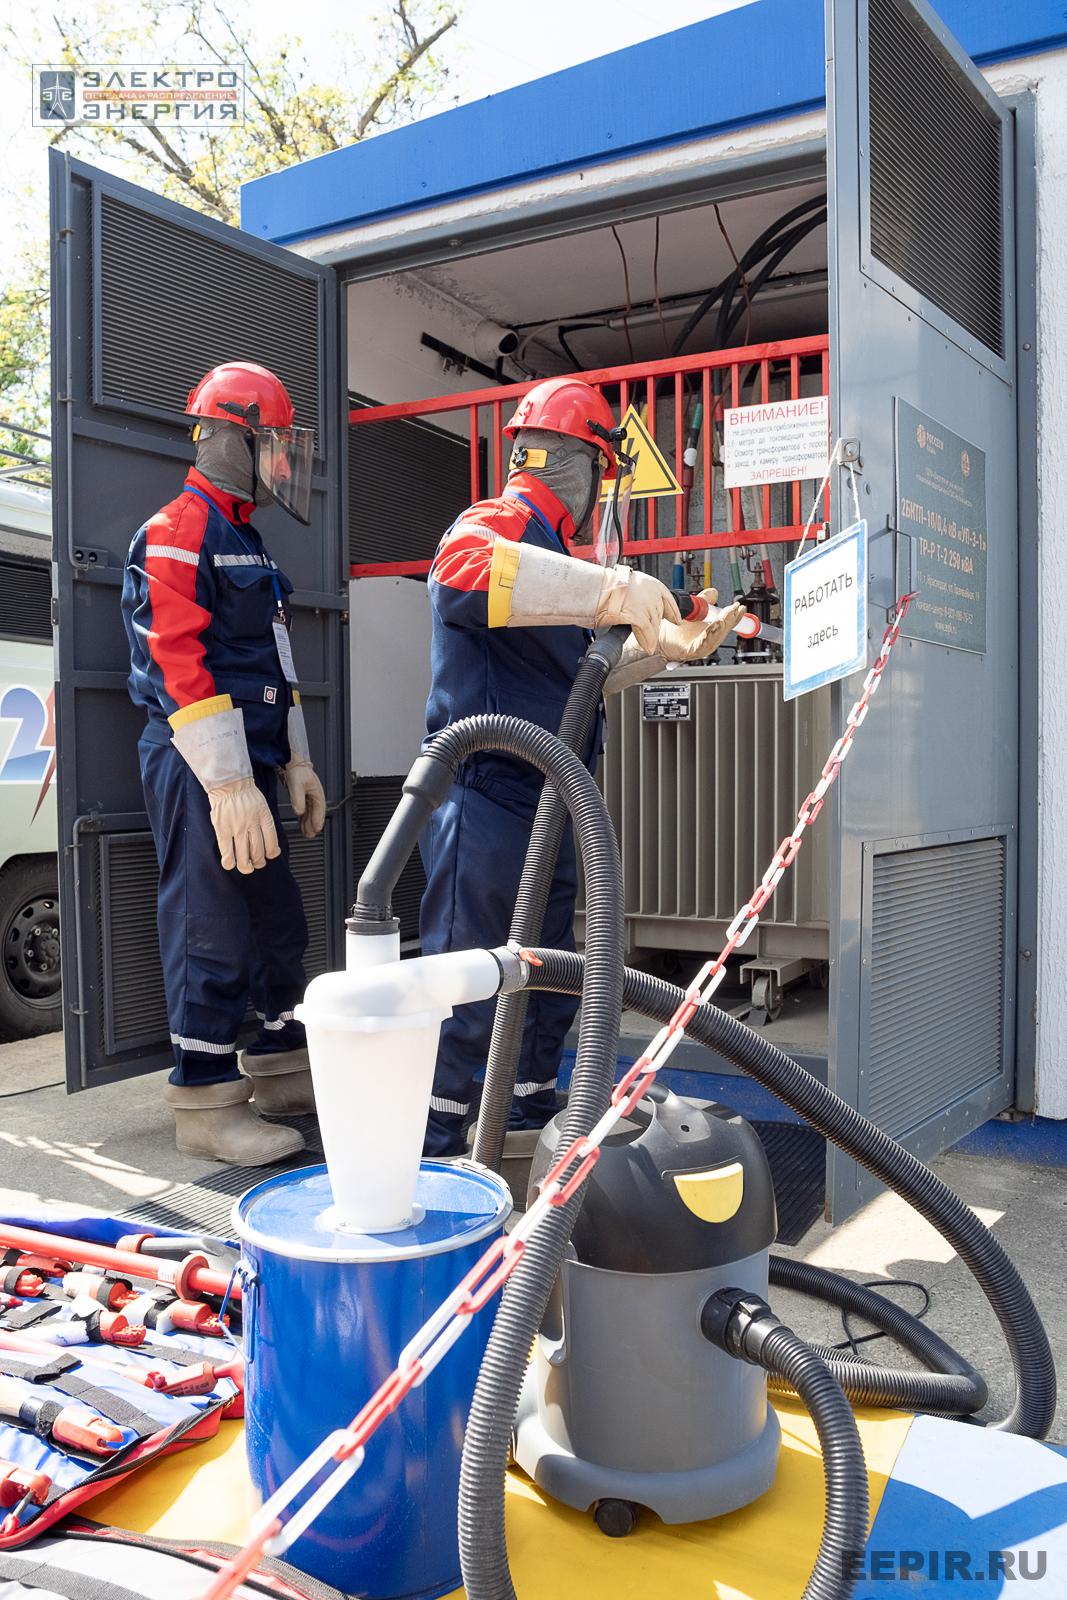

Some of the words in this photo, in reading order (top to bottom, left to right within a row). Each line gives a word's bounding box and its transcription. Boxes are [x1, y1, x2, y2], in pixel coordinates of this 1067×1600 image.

[729, 401, 825, 426] ВНИМАНИЕ!
[750, 466, 808, 481] ЗАПРЕЩЕН!
[794, 571, 853, 615] РАБОТАТЬ
[807, 624, 839, 649] здесь
